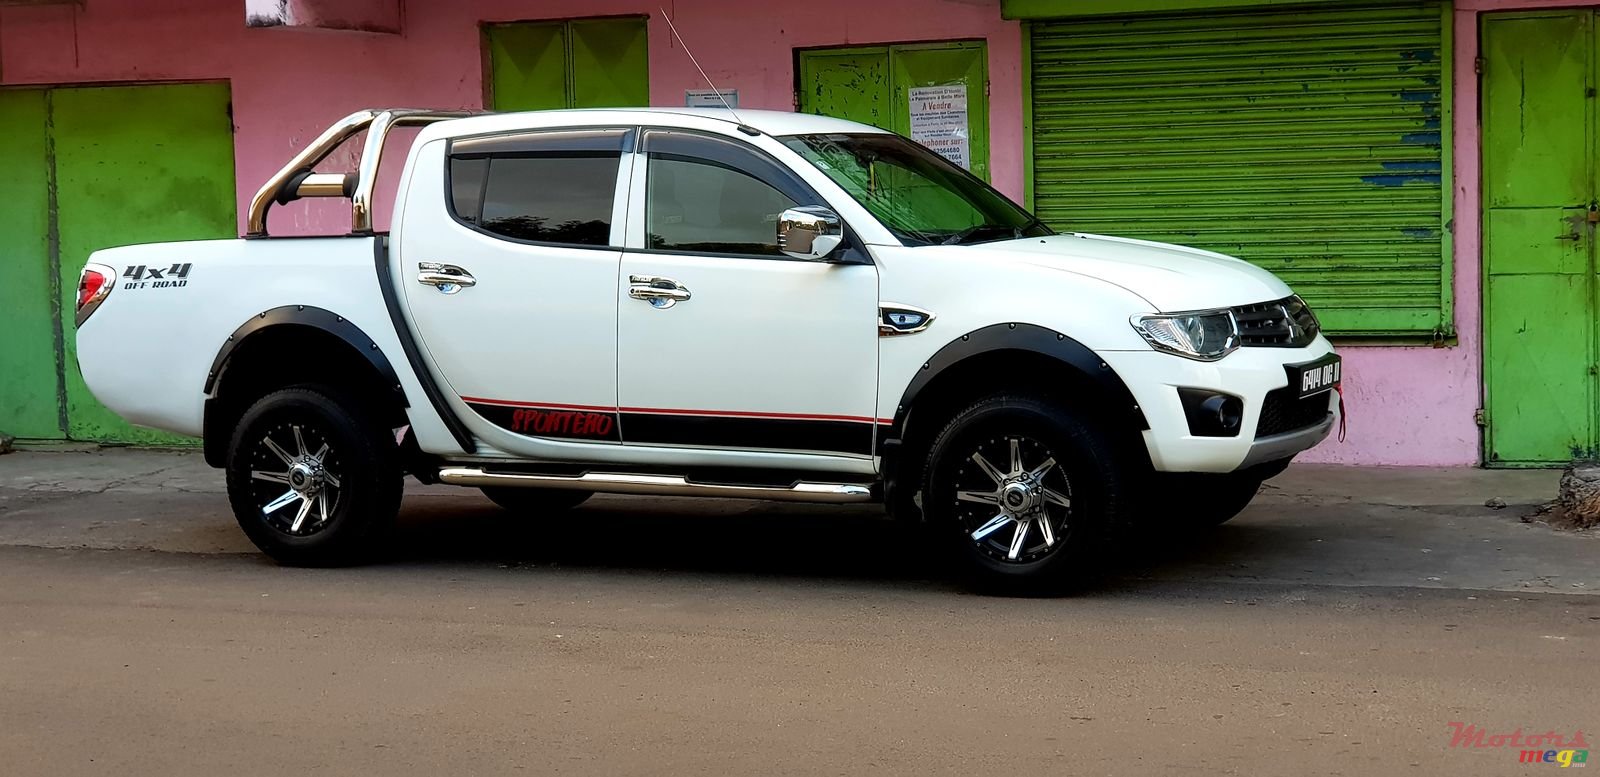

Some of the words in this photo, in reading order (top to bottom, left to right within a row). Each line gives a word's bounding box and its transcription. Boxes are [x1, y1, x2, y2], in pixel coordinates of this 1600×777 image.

[928, 101, 952, 110] Vendre
[123, 263, 192, 281] 4x4
[124, 281, 149, 289] OFF
[152, 280, 187, 288] ROAD
[1303, 367, 1321, 391] 6414
